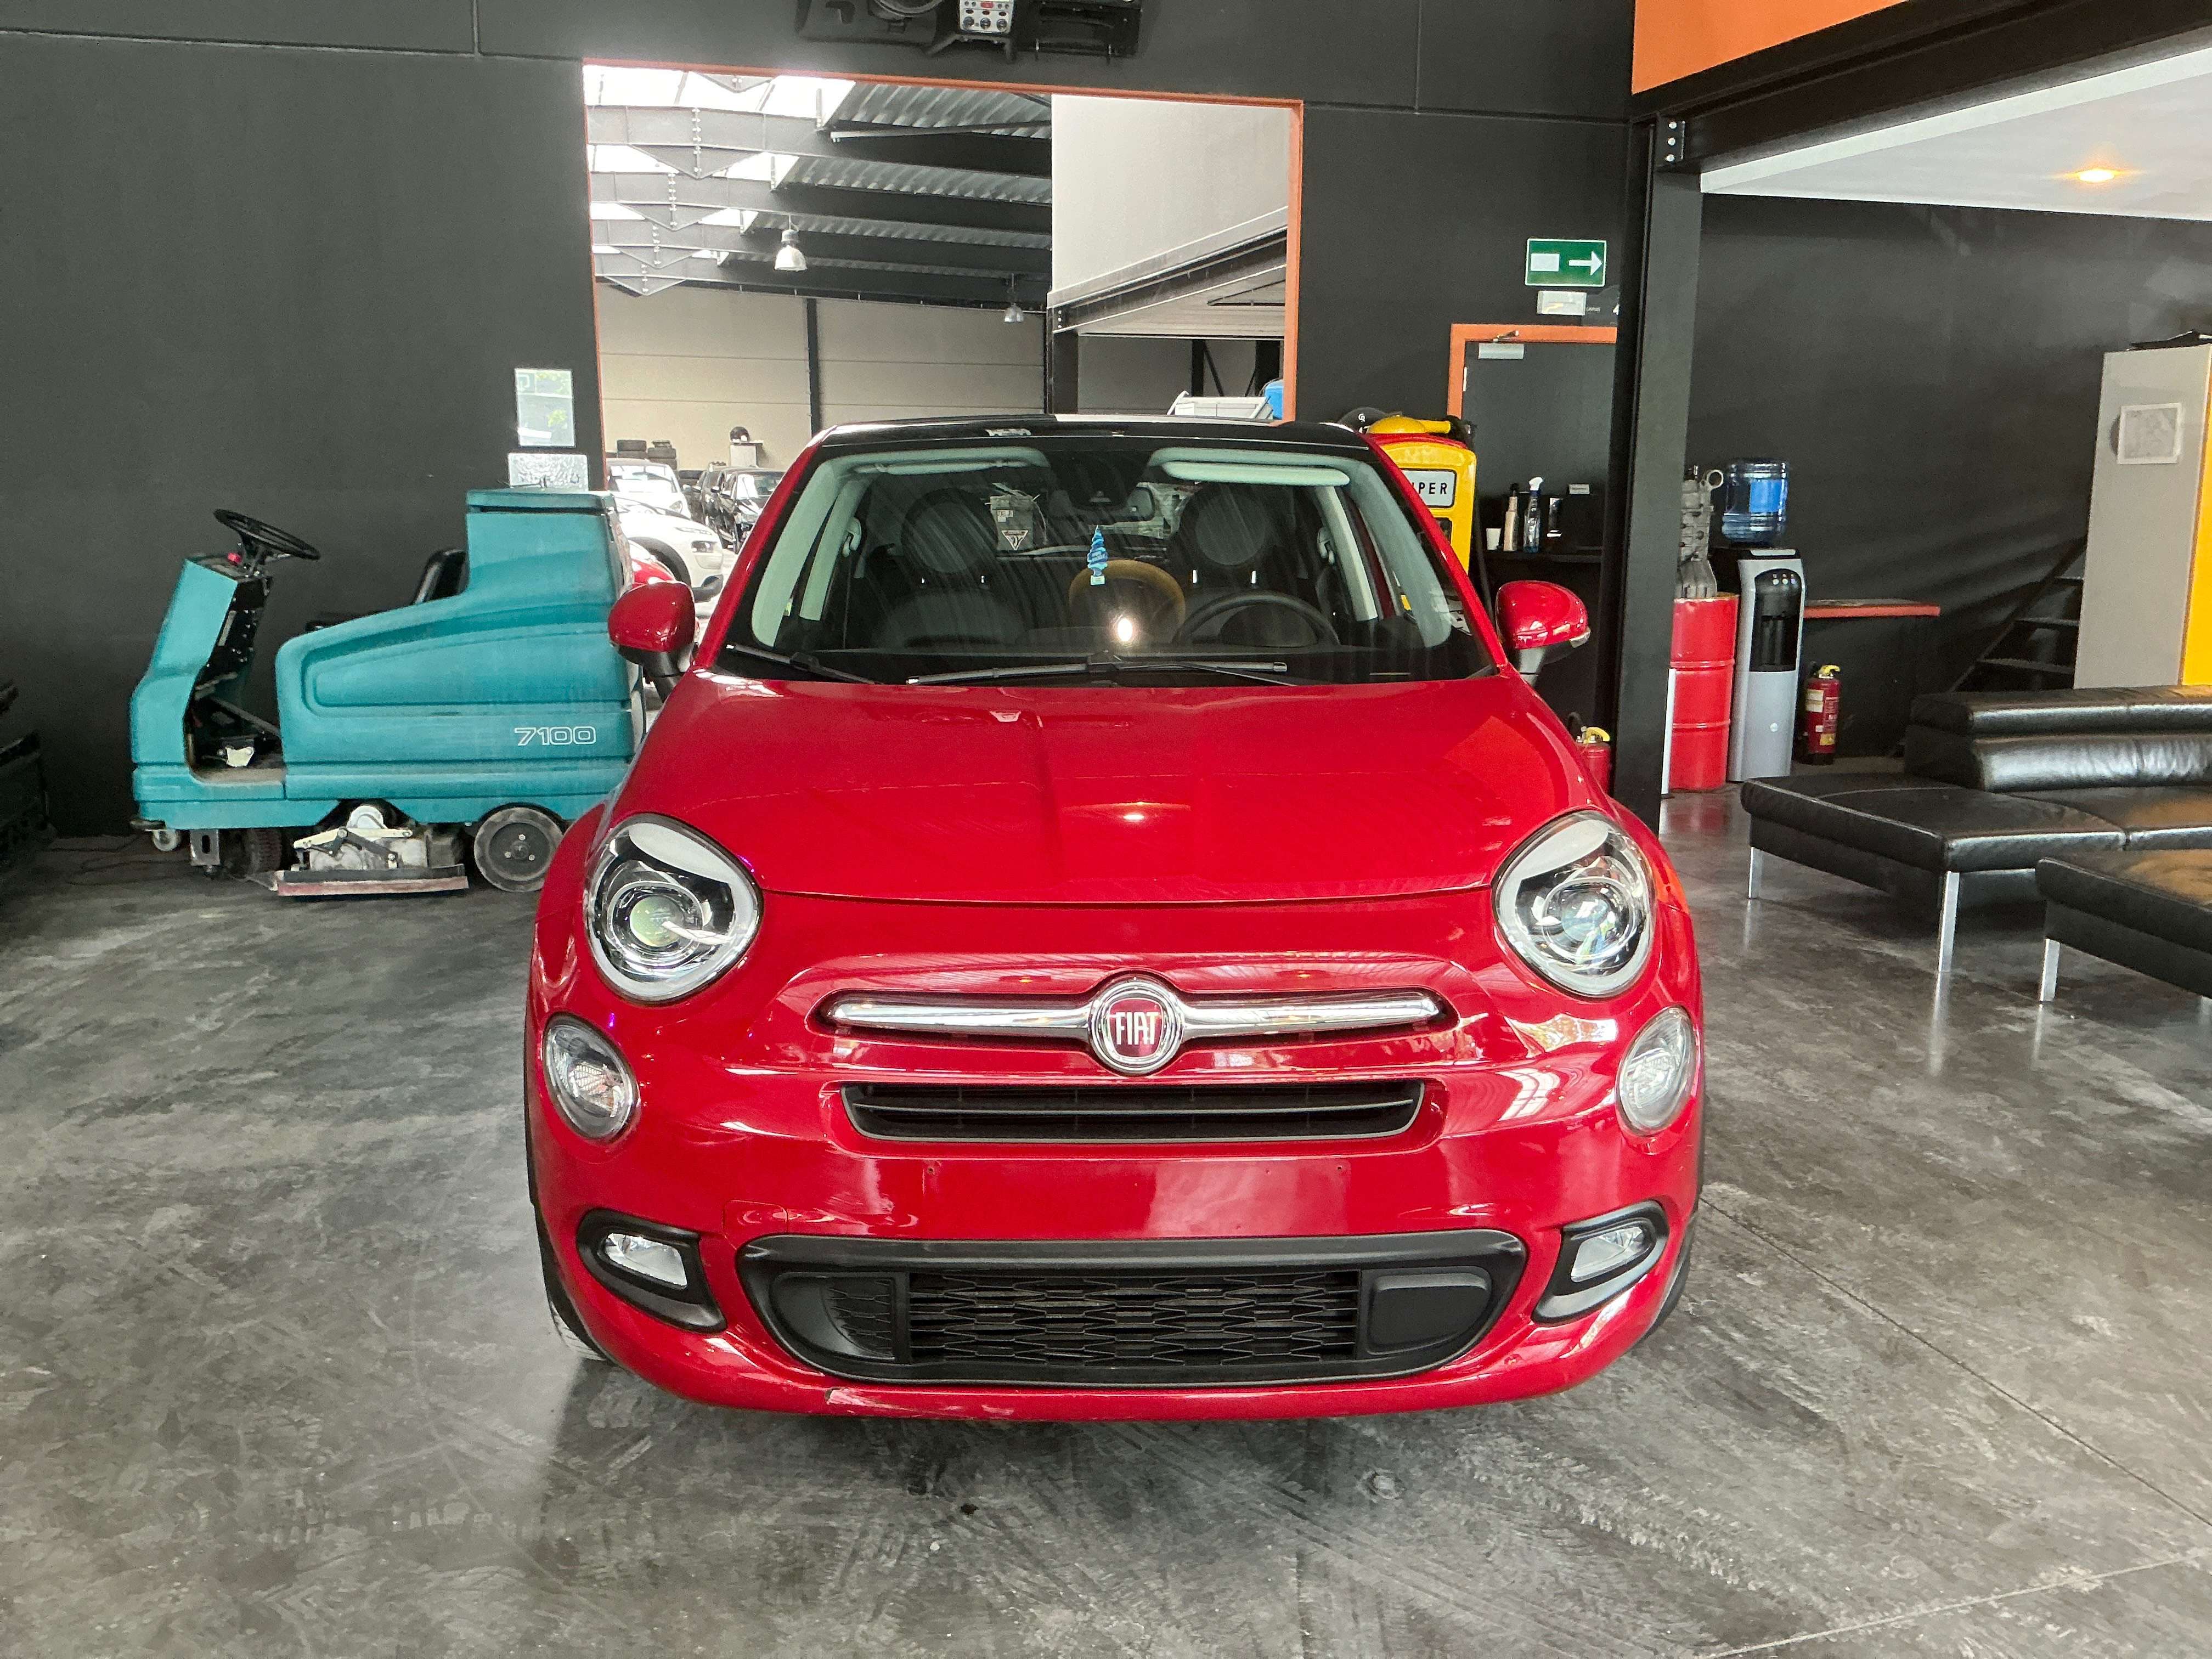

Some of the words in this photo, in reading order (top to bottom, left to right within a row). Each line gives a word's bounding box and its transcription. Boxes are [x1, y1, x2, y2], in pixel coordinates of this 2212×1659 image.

[1412, 482, 1447, 494] PER
[514, 726, 596, 746] 7100
[1115, 1012, 1159, 1045] FIAT
